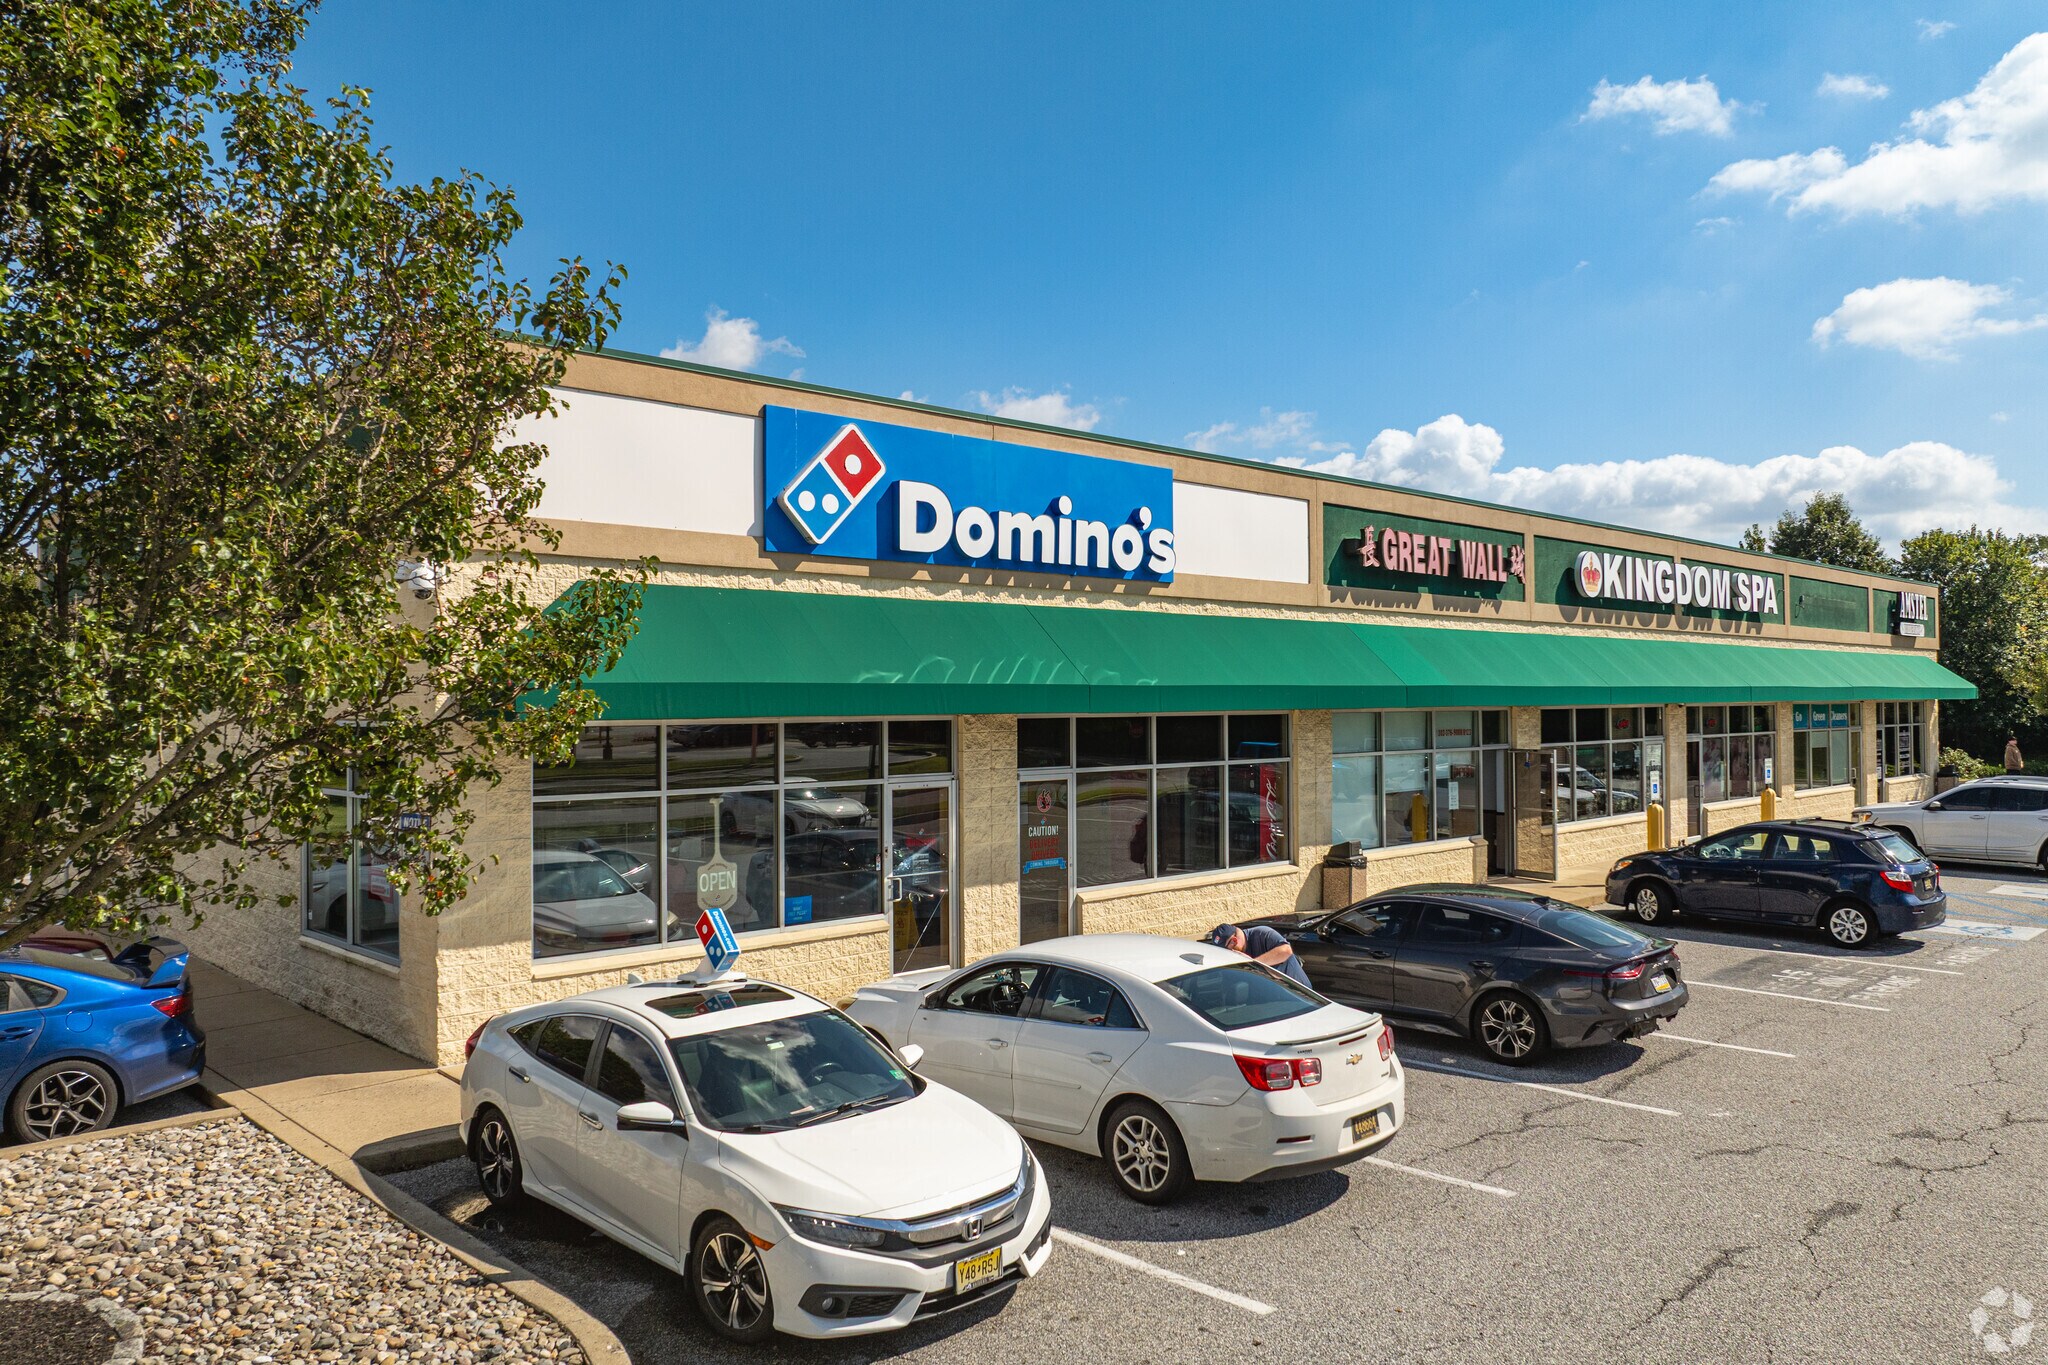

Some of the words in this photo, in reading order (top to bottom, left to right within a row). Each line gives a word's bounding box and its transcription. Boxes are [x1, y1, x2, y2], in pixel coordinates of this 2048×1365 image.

[899, 480, 1176, 574] Domino's
[1382, 527, 1452, 577] GREAT
[1460, 539, 1508, 582] WALL
[1603, 551, 1731, 611] KINGDOM
[1736, 572, 1779, 615] SPA
[1900, 591, 1928, 621] AMSTEL
[1795, 711, 1803, 722] Go
[1812, 710, 1826, 722] Green
[403, 816, 428, 827] NOTIE
[1028, 825, 1059, 837] CAUTION!
[699, 870, 736, 892] OPEN
